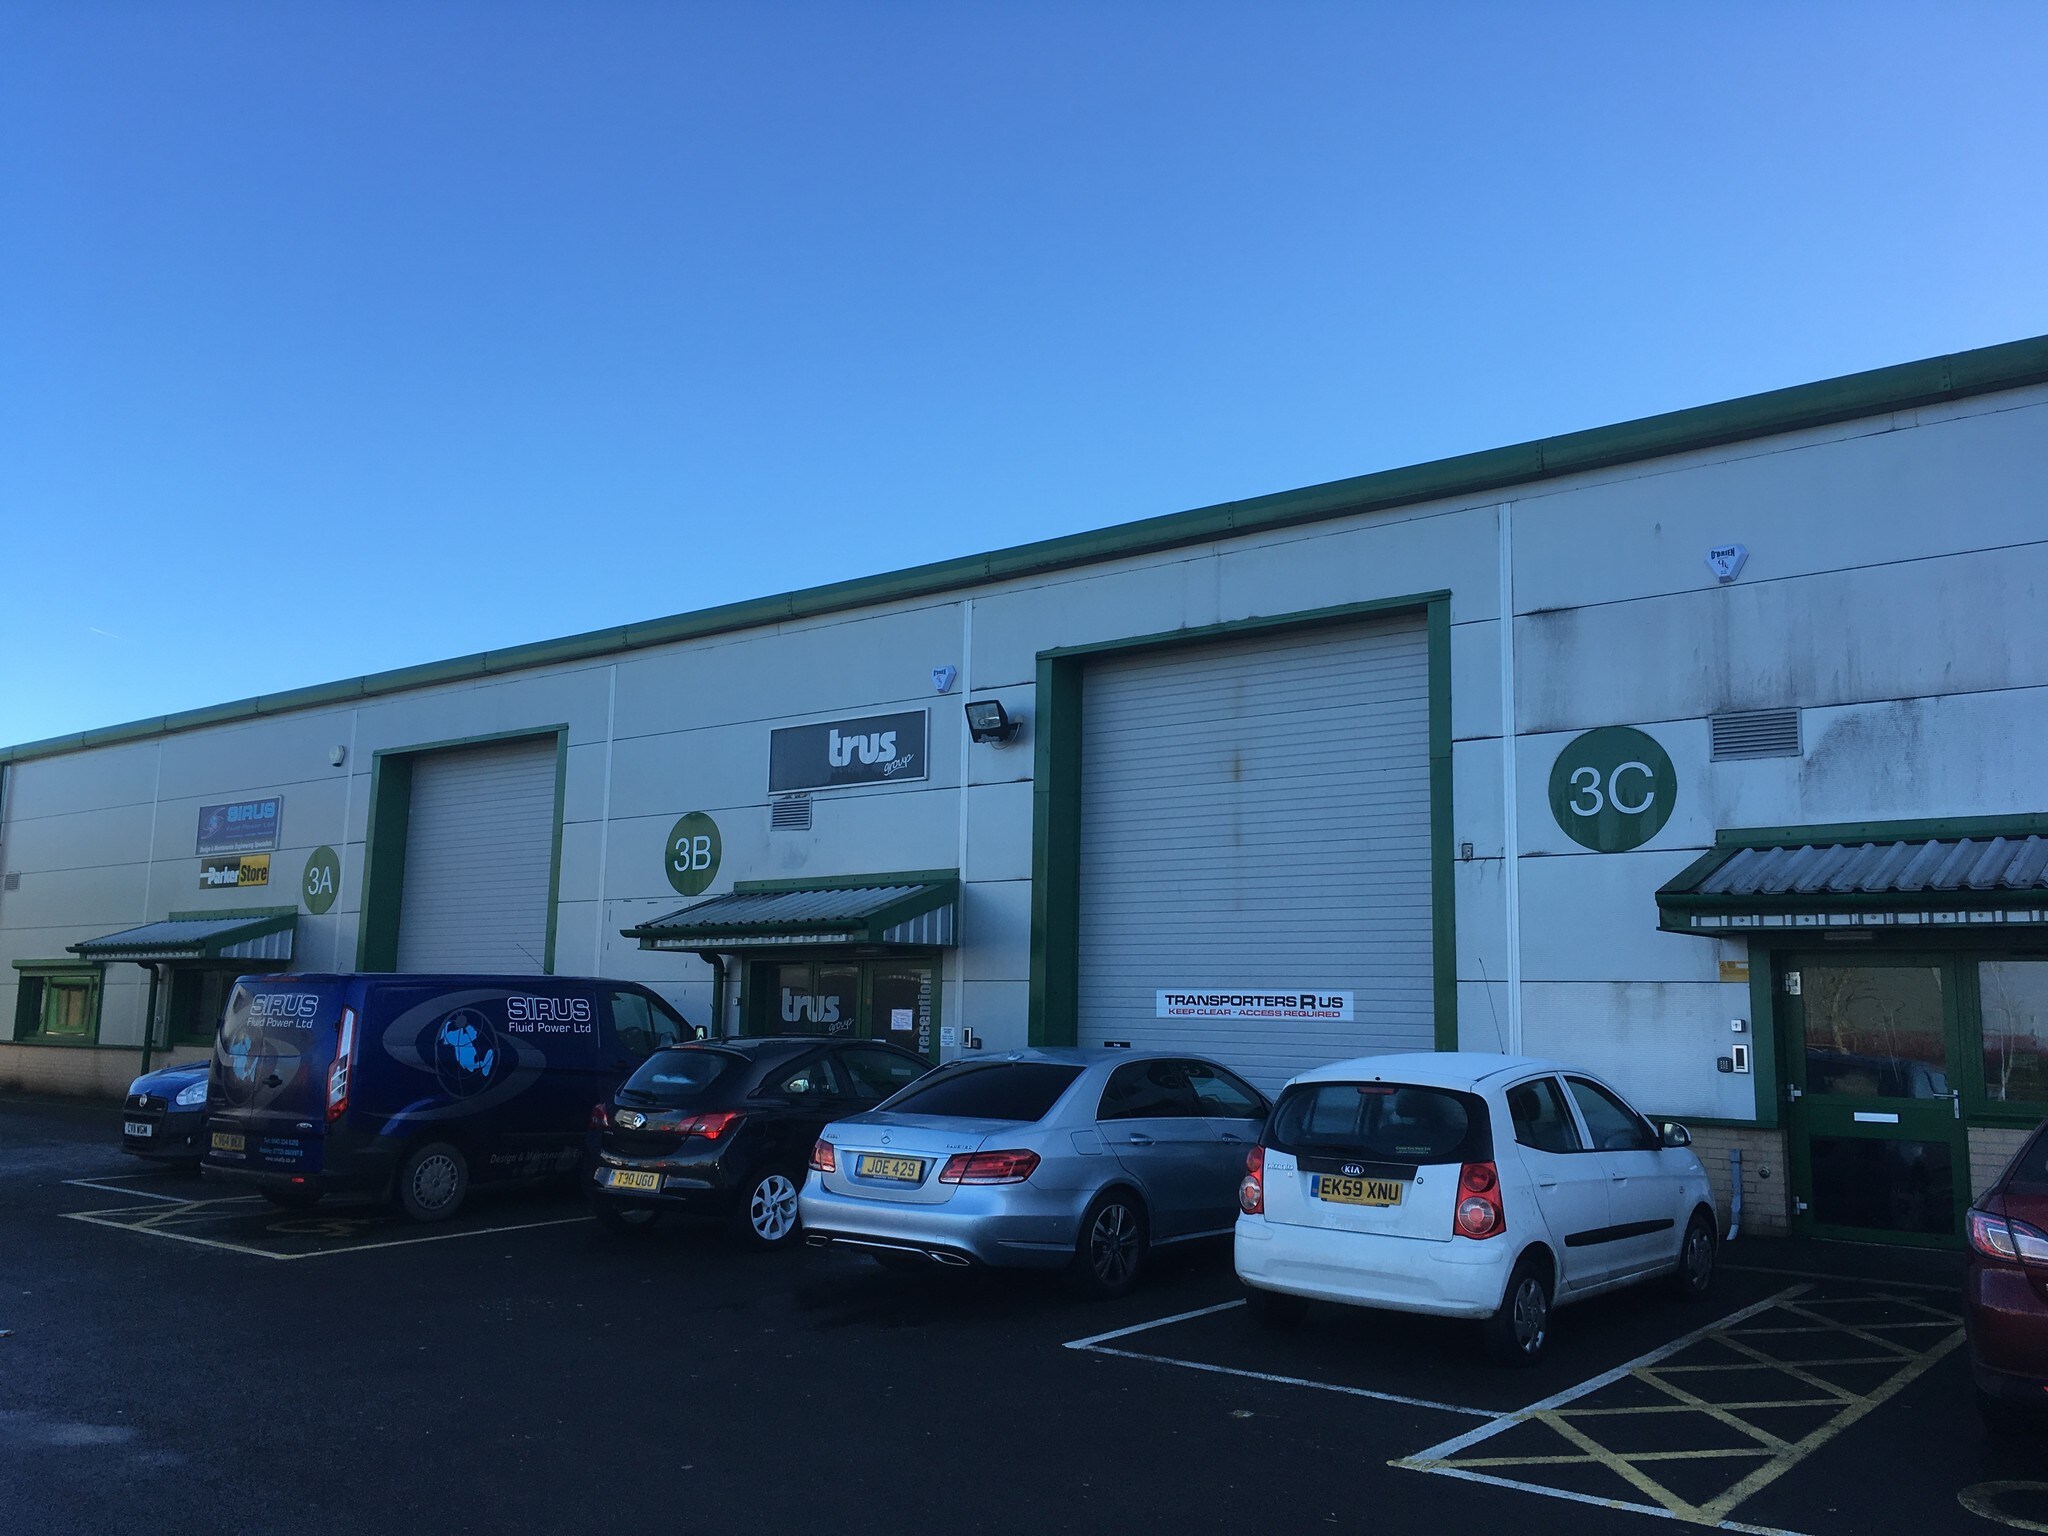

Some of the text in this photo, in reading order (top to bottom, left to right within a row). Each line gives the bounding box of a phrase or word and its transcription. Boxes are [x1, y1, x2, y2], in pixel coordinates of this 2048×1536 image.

[829, 729, 896, 767] trus
[883, 753, 914, 776] group
[1569, 761, 1655, 816] 3C
[227, 802, 275, 822] SIRUS
[674, 835, 711, 872] 3B
[308, 866, 332, 895] 3A
[250, 994, 319, 1018] SIRUS
[507, 997, 590, 1021] SIRUS
[781, 987, 840, 1022] trus
[1165, 994, 1343, 1009] TRANSPORTERS R US
[1197, 1008, 1231, 1016] CLEAR
[1238, 1009, 1282, 1017] ACCESS
[1284, 1010, 1341, 1018] REQUIRED
[247, 1017, 313, 1028] Fluid Power Ltd
[917, 973, 931, 1054] reception
[509, 1022, 591, 1033] Fluid Power Ltd
[617, 1172, 635, 1185] T30
[867, 1158, 916, 1177] JOE 429
[1344, 1165, 1361, 1174] KIA
[1320, 1177, 1400, 1201] EK59 XNU
